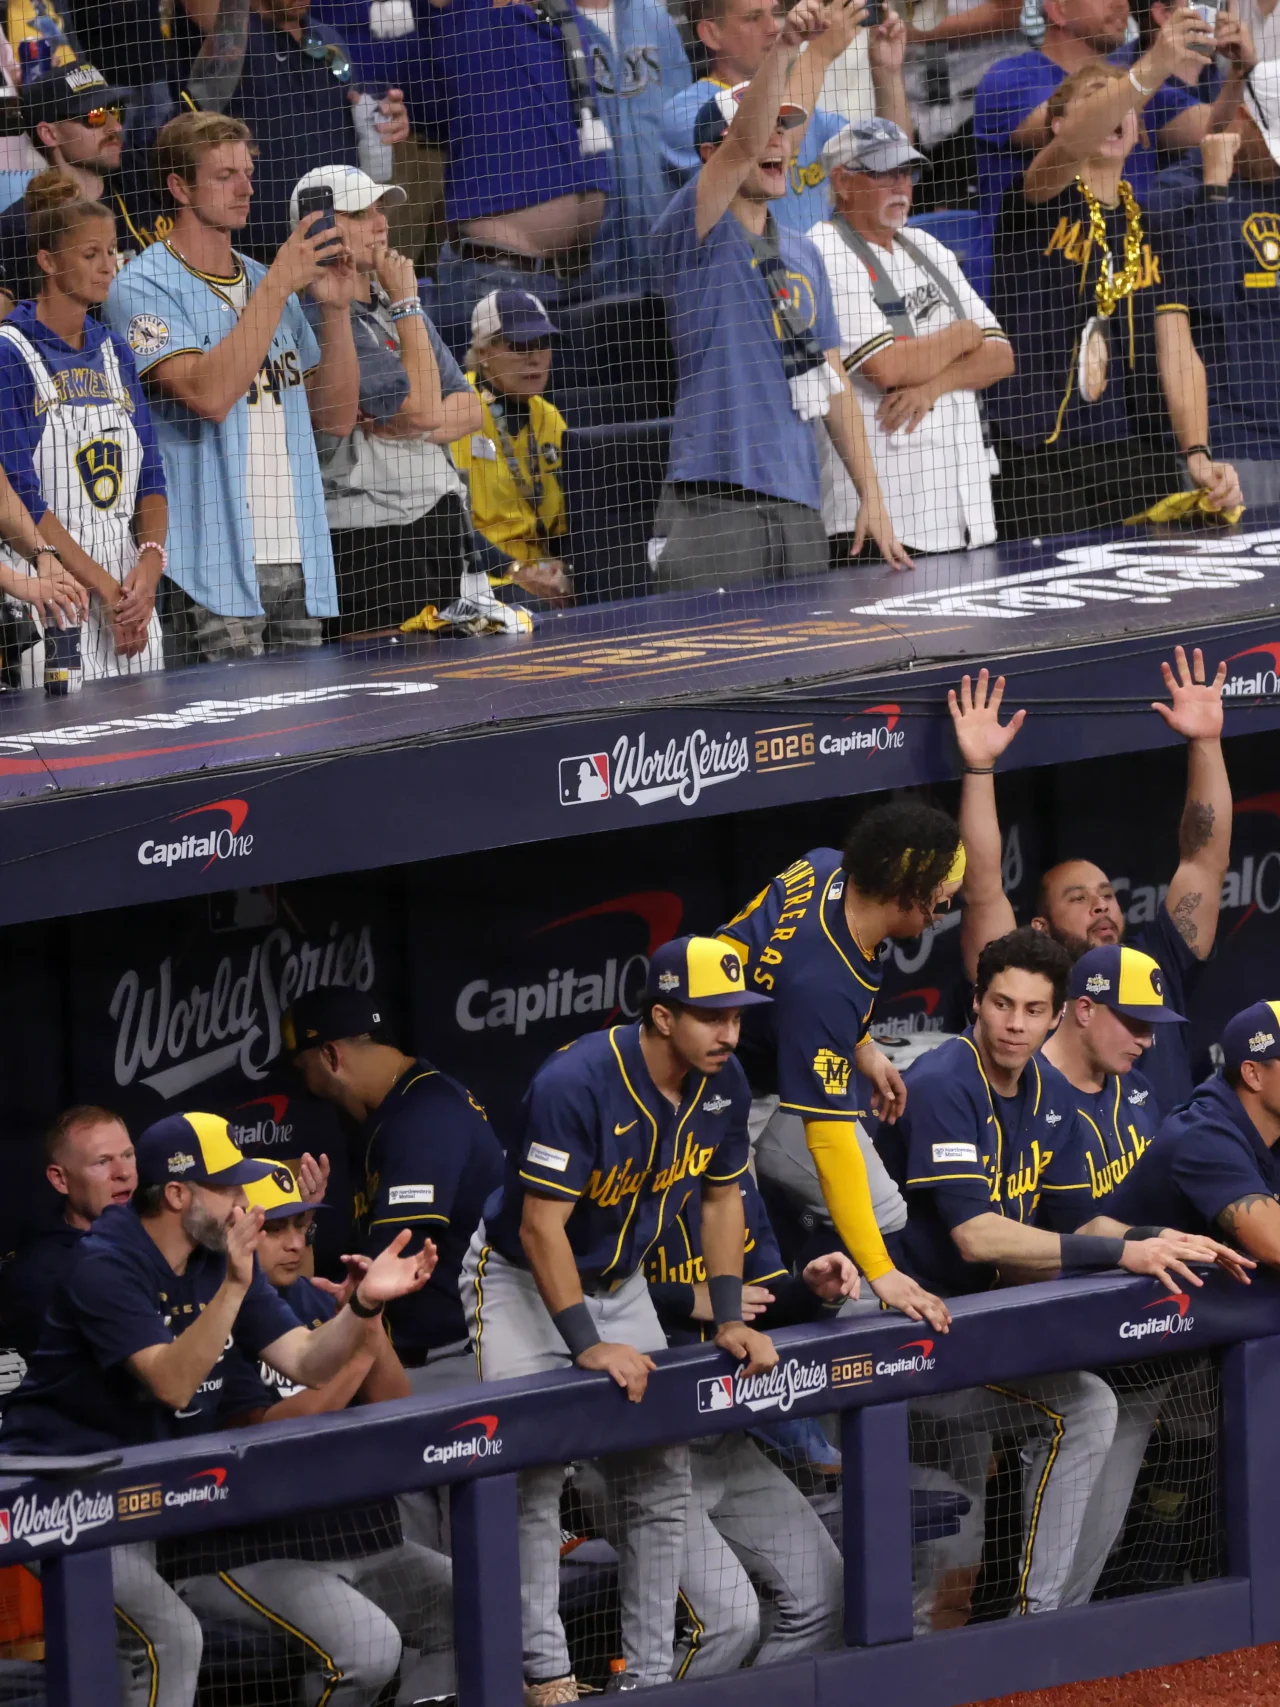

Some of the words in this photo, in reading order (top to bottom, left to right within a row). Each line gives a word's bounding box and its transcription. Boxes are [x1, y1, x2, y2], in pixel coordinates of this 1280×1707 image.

[755, 732, 815, 763] 2026
[831, 1360, 873, 1382] 2026
[117, 1490, 163, 1515] 2026
